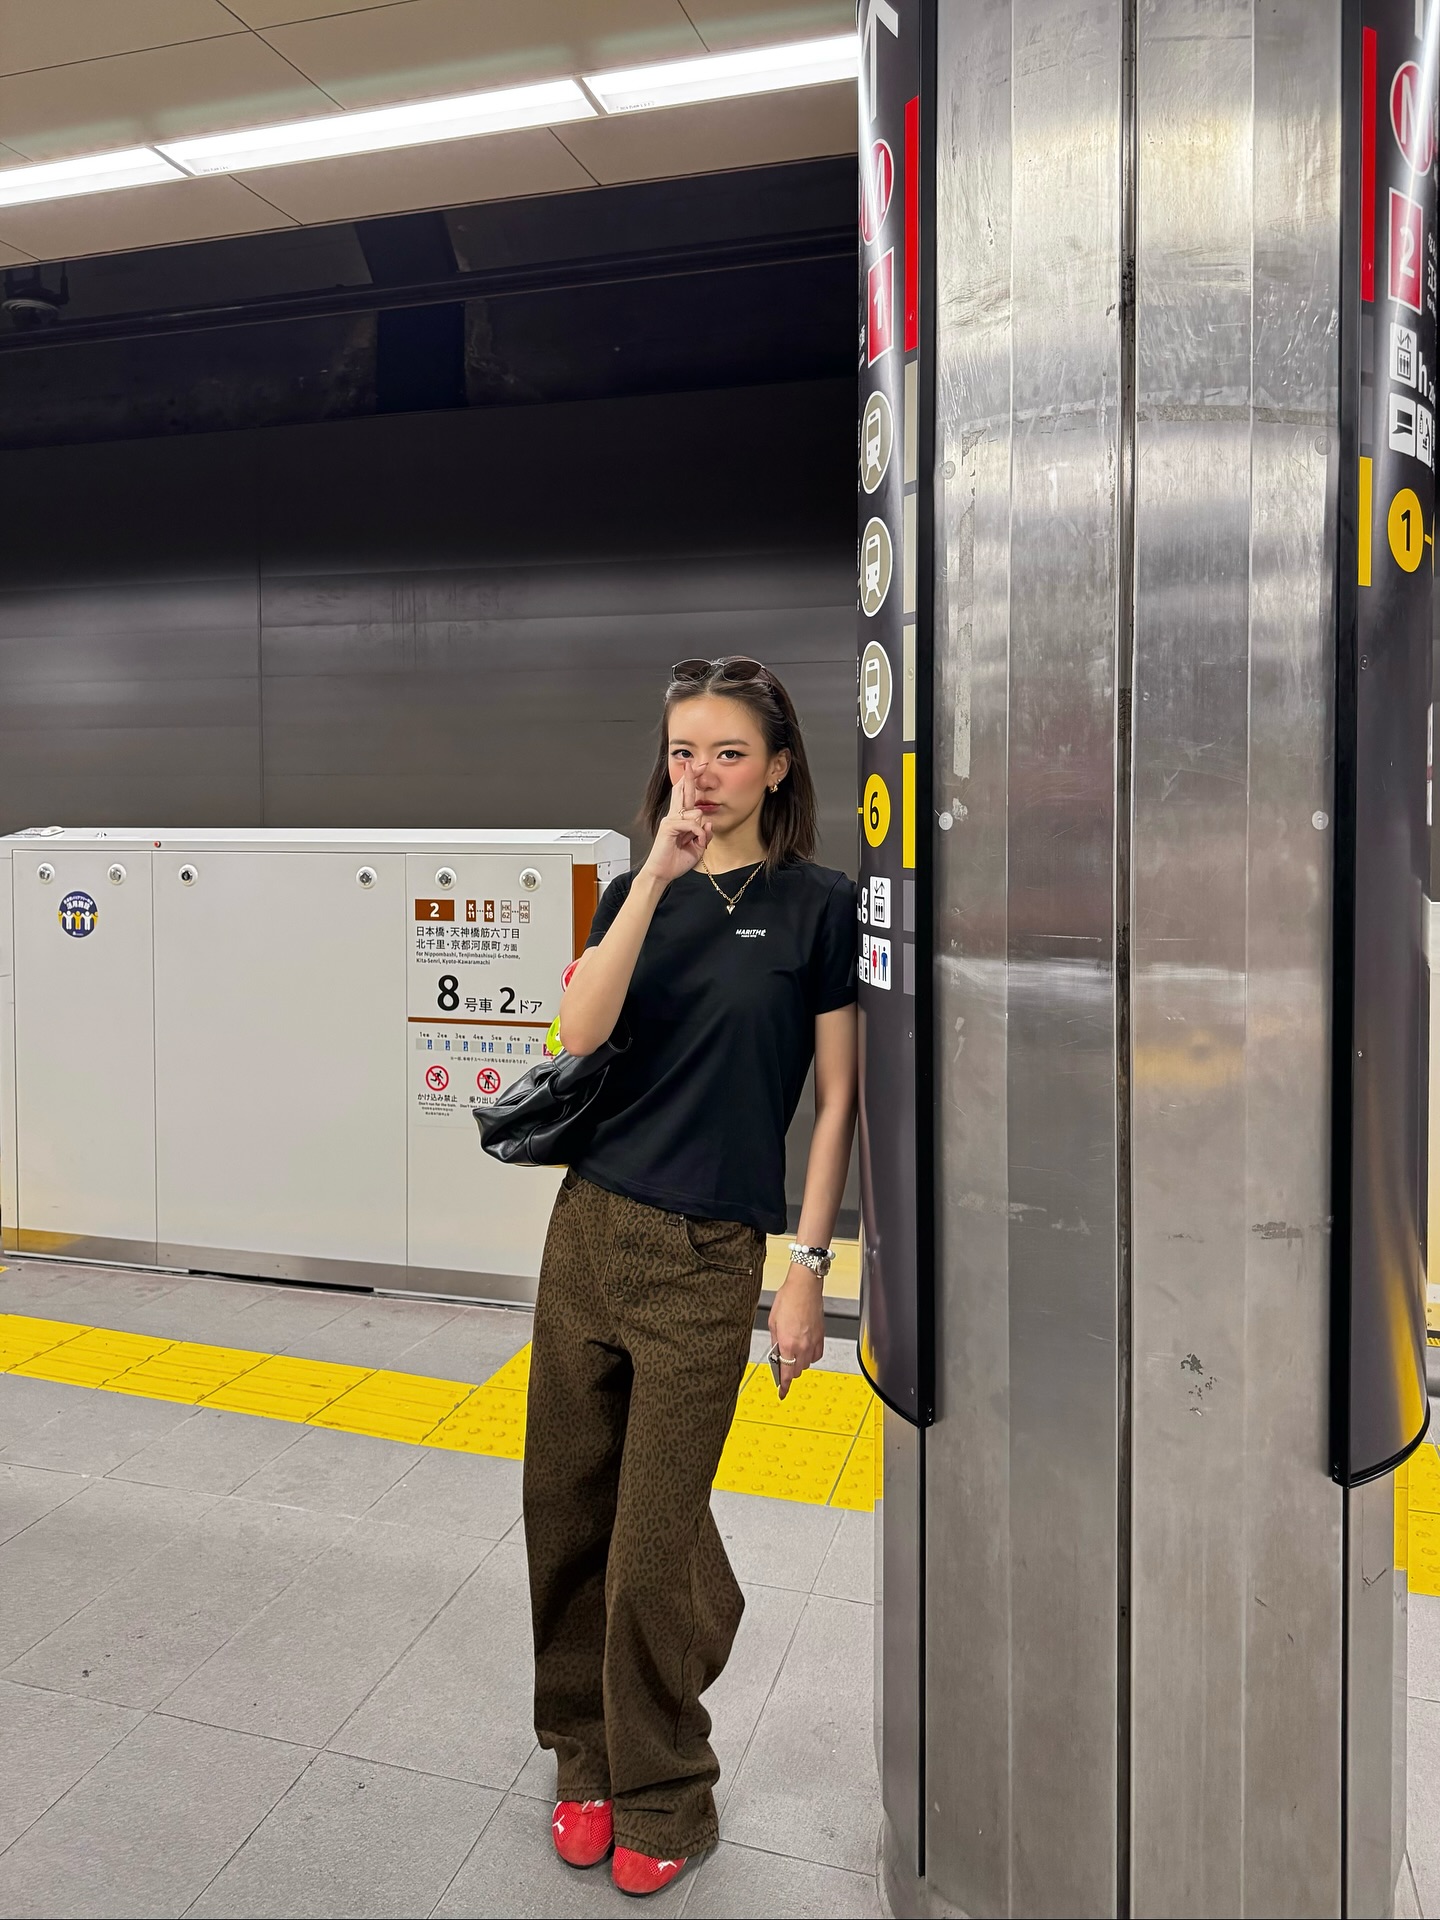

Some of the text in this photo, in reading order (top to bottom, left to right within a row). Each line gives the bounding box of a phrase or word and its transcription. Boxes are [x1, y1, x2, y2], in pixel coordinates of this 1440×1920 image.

[1400, 226, 1415, 278] 2
[873, 284, 884, 330] 1
[1400, 509, 1411, 552] 1
[869, 791, 880, 830] 6
[429, 902, 440, 918] 2
[468, 903, 475, 911] K
[485, 911, 494, 919] 18
[417, 1093, 458, 1103] かけ込み禁止
